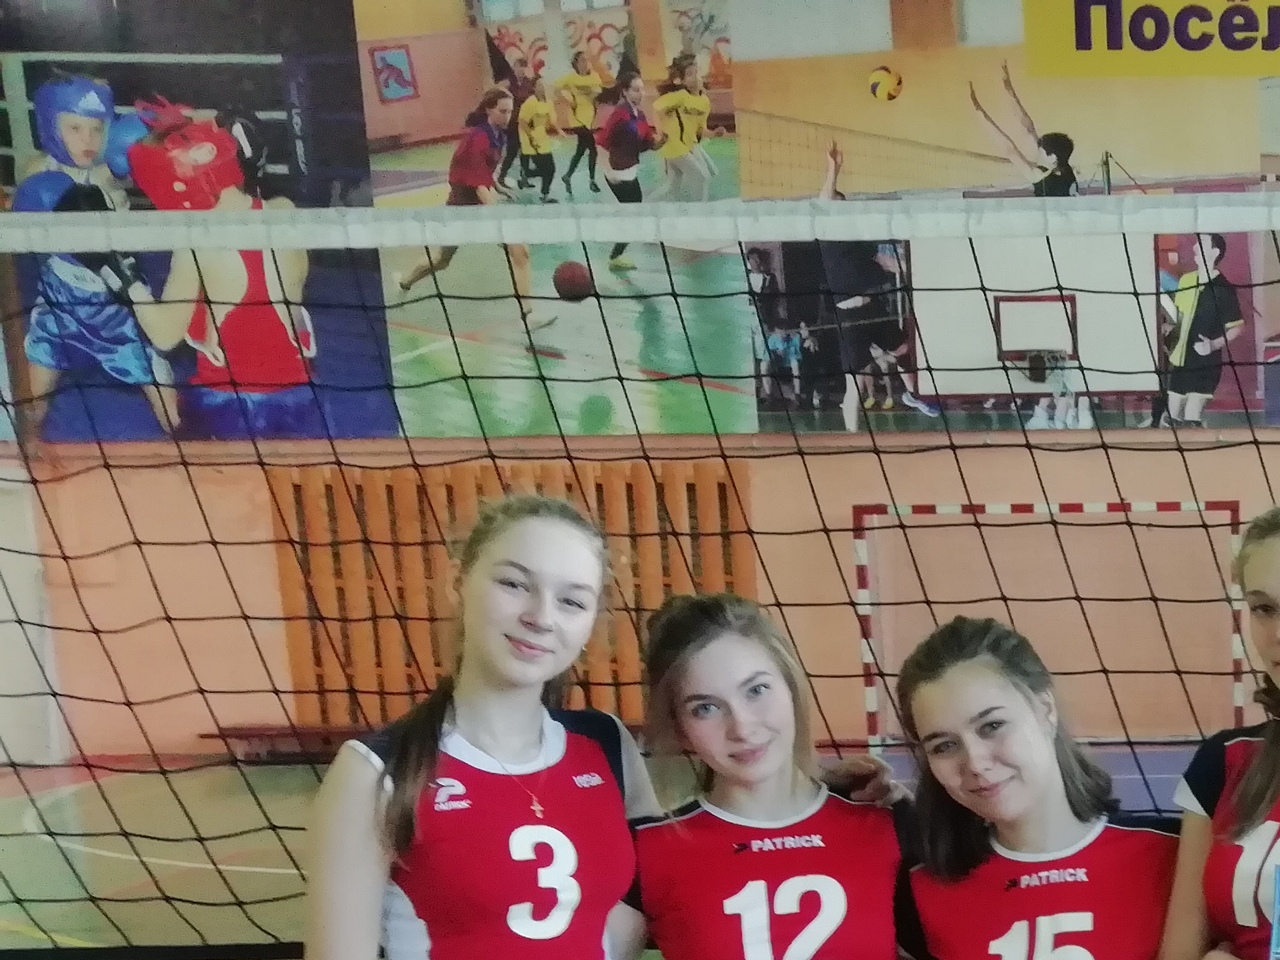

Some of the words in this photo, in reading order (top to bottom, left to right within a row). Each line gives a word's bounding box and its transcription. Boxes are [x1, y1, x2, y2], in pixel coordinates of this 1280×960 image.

[751, 834, 826, 852] PATRICK
[506, 824, 582, 940] 3
[1020, 868, 1089, 889] PATRICK
